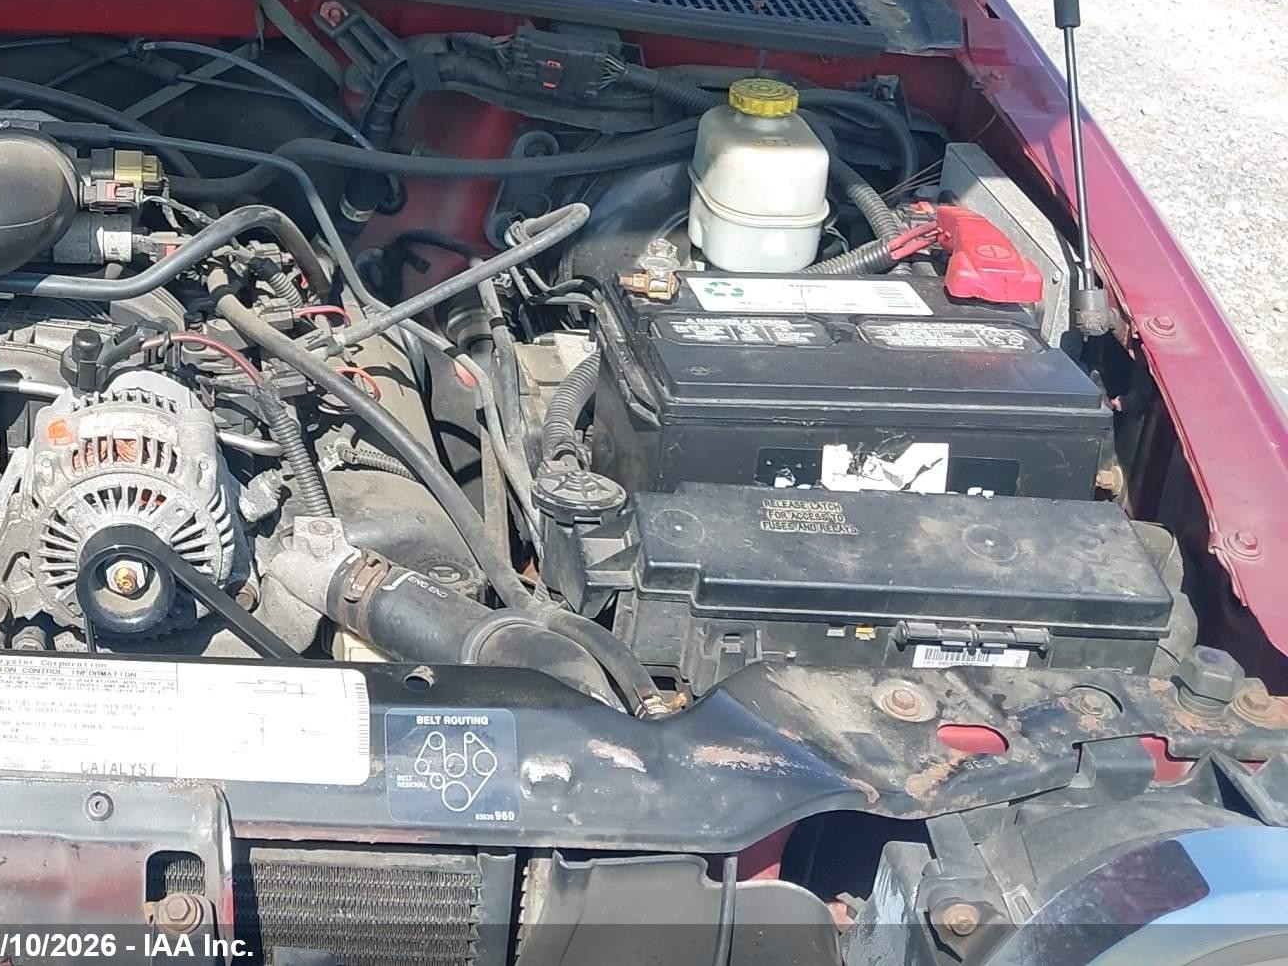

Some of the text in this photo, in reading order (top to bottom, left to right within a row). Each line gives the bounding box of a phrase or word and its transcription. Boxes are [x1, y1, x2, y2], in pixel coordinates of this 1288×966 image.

[763, 499, 843, 512] RELEASE LATCH
[768, 510, 845, 523] FOR ACCESS TO
[761, 521, 858, 534] FUSES AND RELAYS
[407, 576, 449, 599] ENG END
[40, 659, 108, 670] Corporation
[22, 667, 63, 675] CONTROL
[71, 670, 137, 679] INFORMATION
[416, 715, 489, 726] BELT ROUTING
[397, 781, 429, 789] REMOVAL
